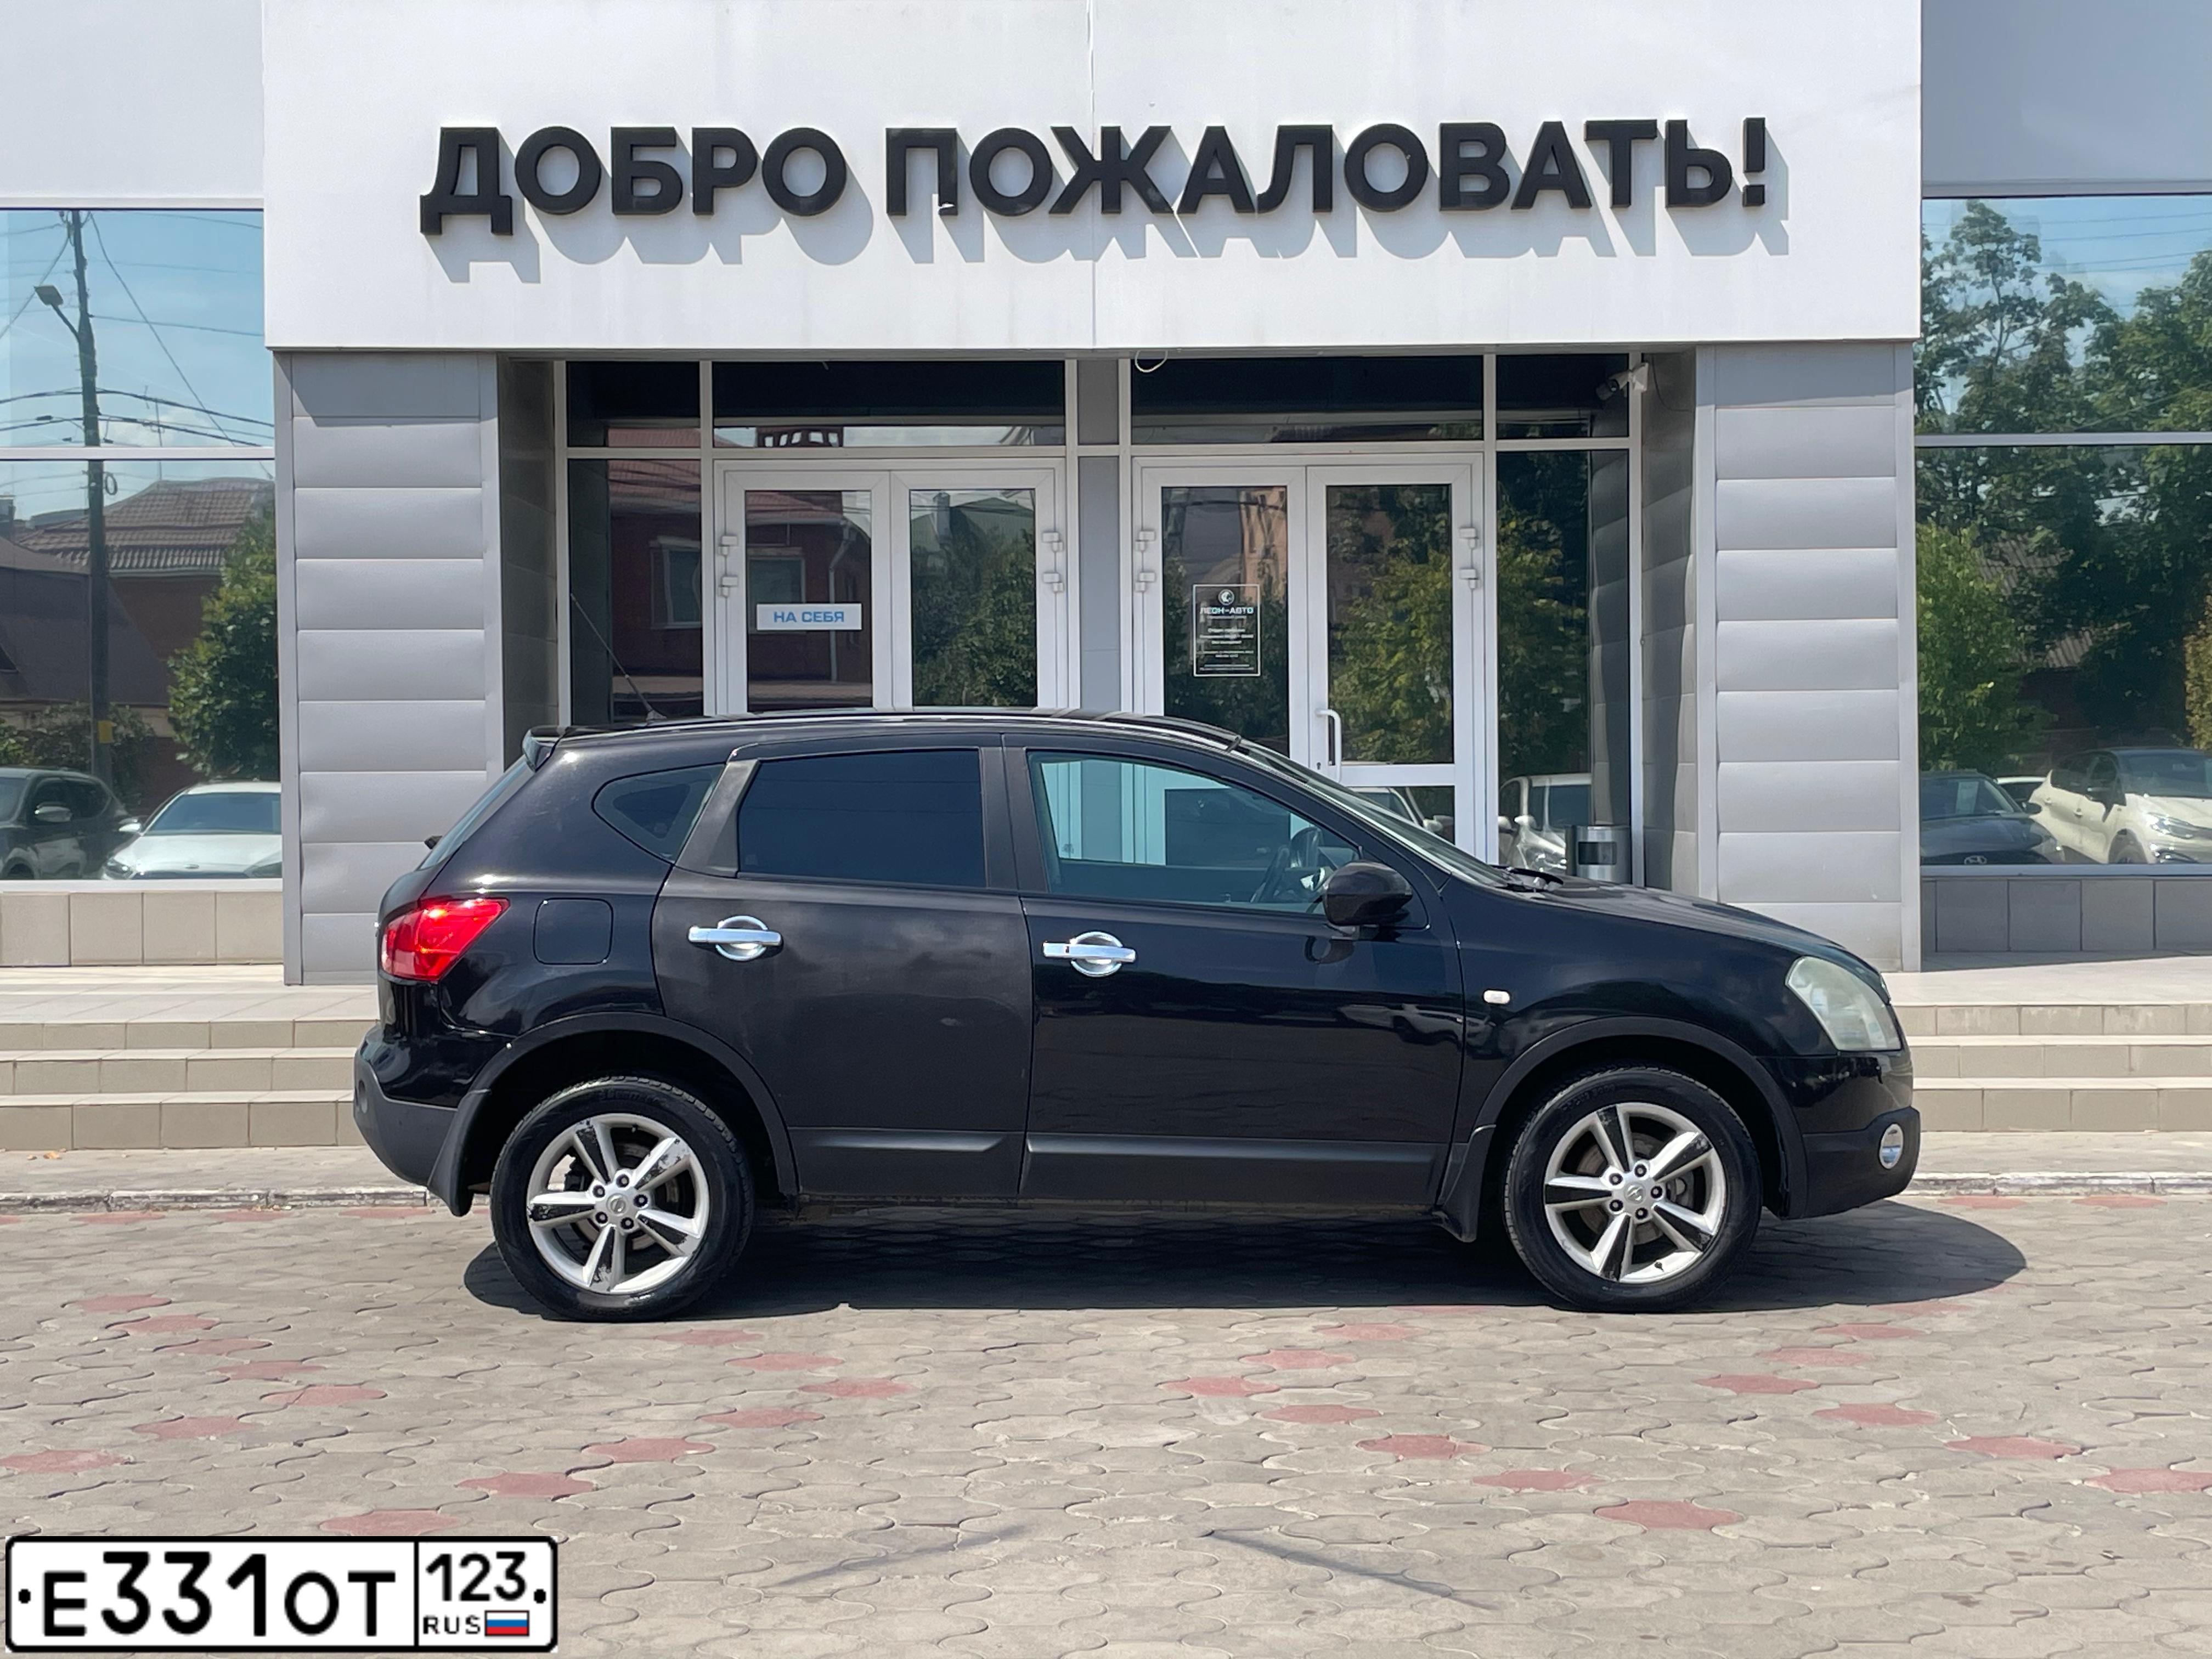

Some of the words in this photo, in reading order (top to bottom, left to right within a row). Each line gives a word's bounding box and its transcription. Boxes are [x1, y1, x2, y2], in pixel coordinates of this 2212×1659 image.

[419, 126, 848, 237] ДОБРО
[885, 117, 1767, 217] ПОЖАЛОВАТЬ!
[774, 611, 797, 623] НА
[802, 611, 844, 623] СЕБЯ
